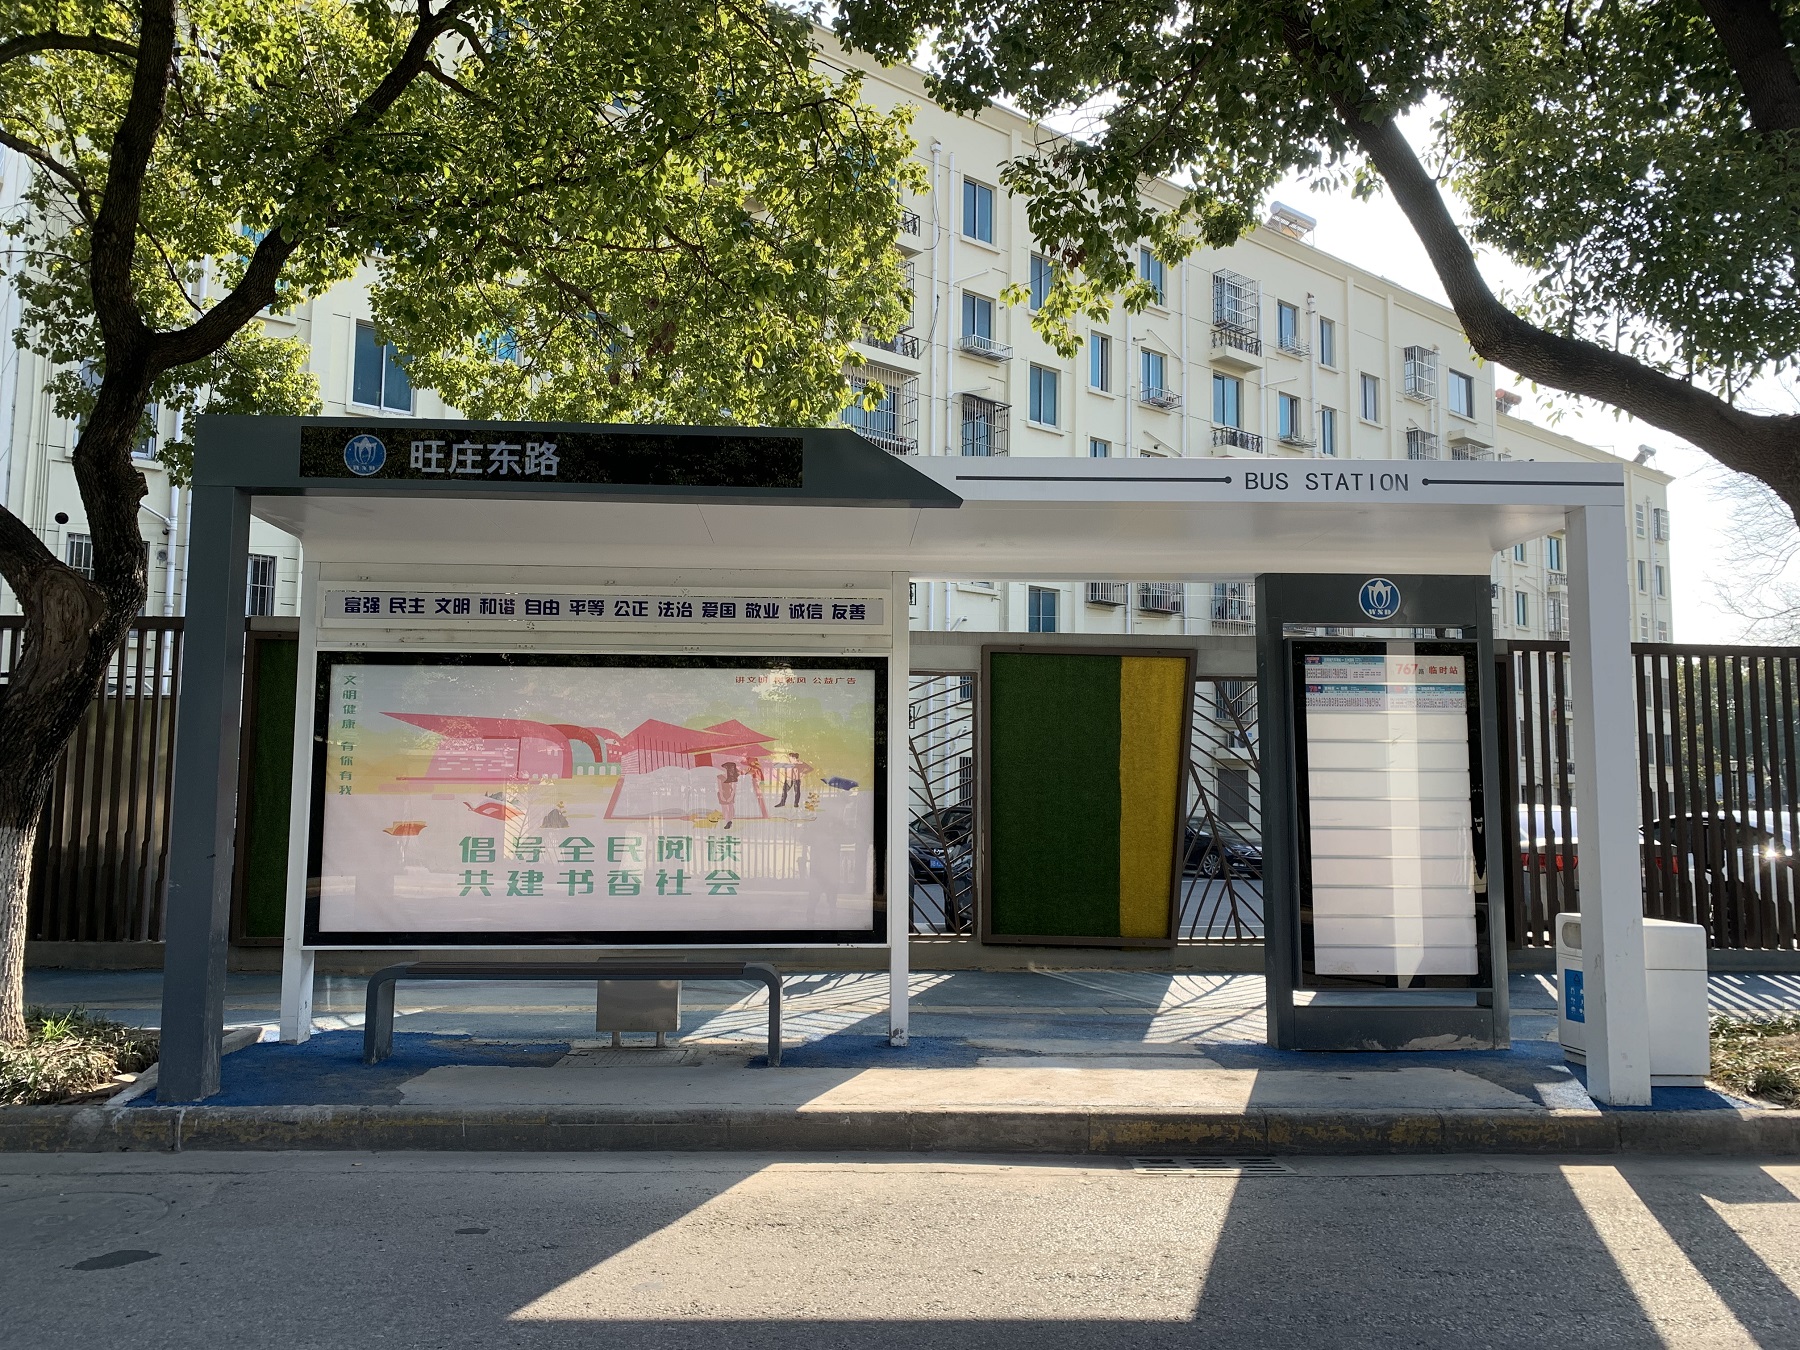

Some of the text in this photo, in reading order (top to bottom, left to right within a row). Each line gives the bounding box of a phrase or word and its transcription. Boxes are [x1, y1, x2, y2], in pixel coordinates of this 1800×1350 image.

[410, 439, 561, 476] 旺庄东路
[1245, 472, 1410, 491] BUS STATION
[344, 597, 866, 620] 富强 民主 文明 和谐 自由 平等 公正 法治 爱国 敬业 诚信 友善
[735, 676, 768, 684] 讲文明
[813, 676, 857, 685] 公益广告
[1428, 665, 1459, 675] 临时站
[339, 675, 357, 796] 文明健康 有你有我
[459, 835, 742, 863] 倡导全民阅读
[457, 869, 741, 897] 共建书香社会
